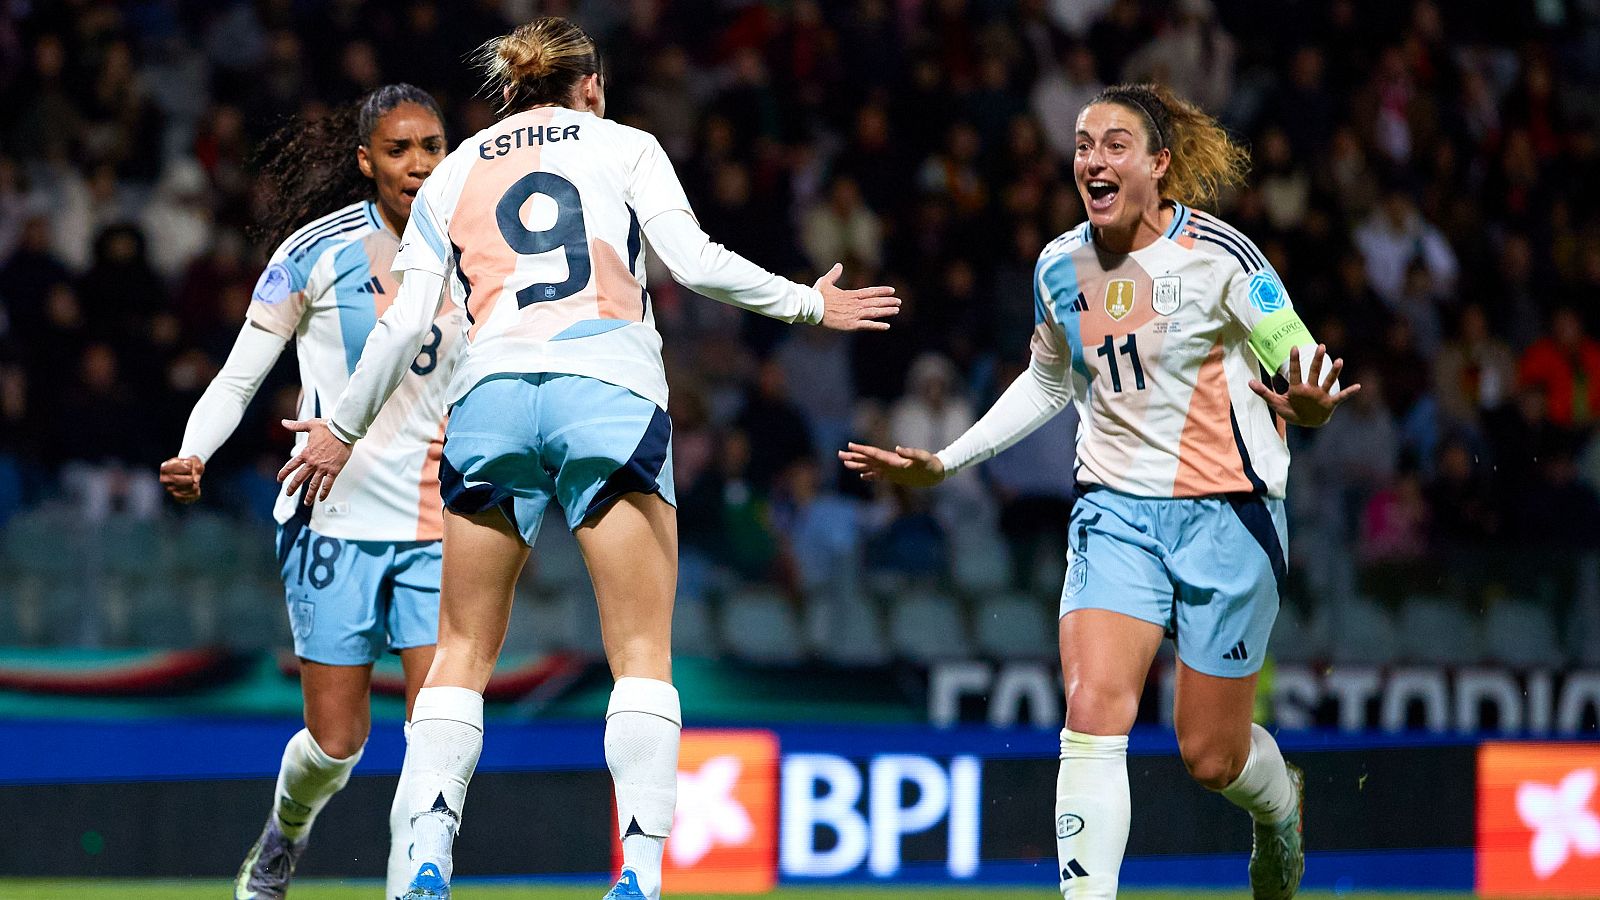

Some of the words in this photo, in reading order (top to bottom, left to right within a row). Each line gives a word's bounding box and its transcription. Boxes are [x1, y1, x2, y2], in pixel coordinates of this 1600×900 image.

[479, 124, 581, 161] ESTHER
[495, 171, 592, 311] 9
[410, 322, 443, 376] 8
[1097, 333, 1146, 393] 11
[296, 528, 342, 590] 18
[781, 752, 982, 878] BPI
